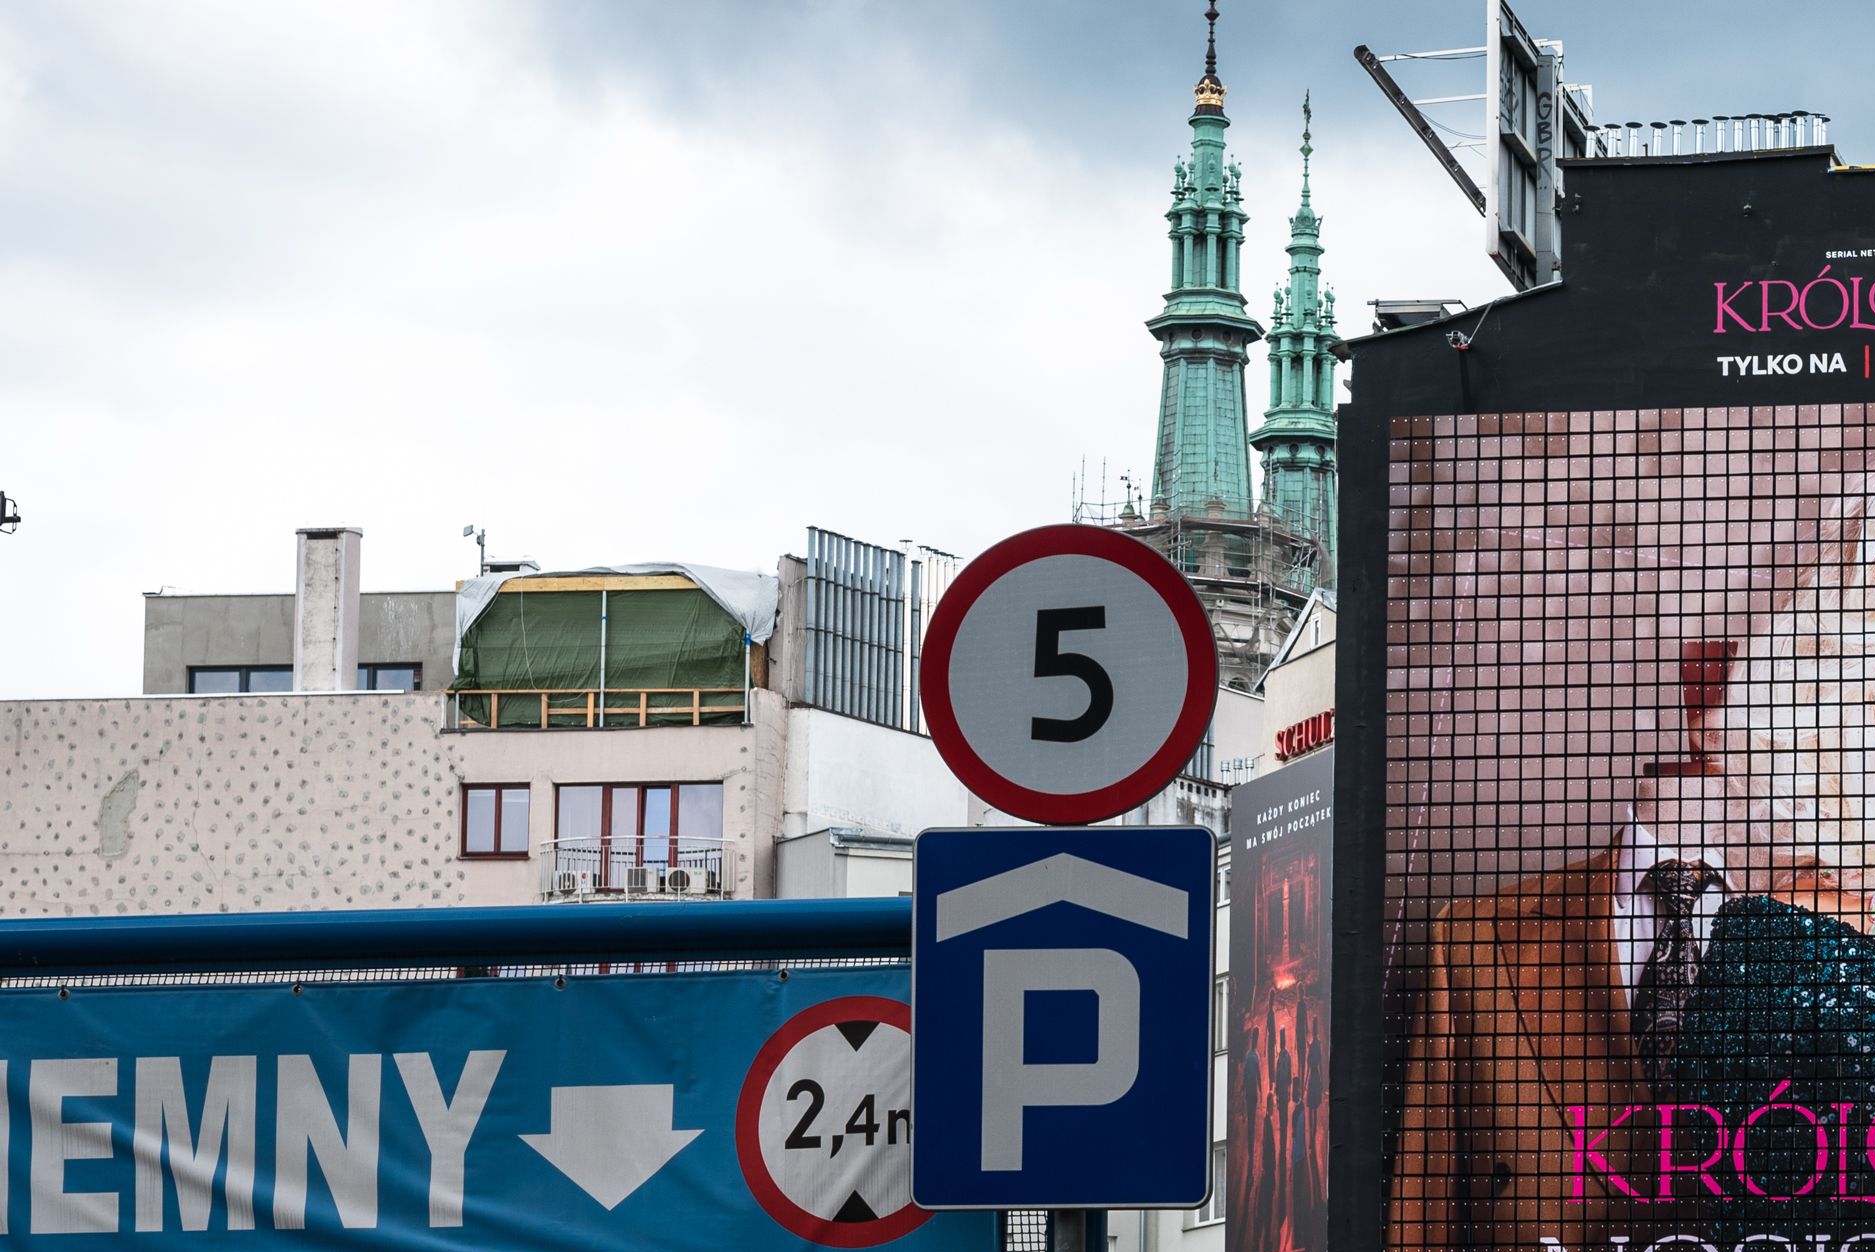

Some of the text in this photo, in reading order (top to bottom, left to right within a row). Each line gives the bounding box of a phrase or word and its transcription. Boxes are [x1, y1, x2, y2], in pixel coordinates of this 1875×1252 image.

[1825, 250, 1858, 259] SERIAL
[1716, 353, 1803, 377] TYLKO
[1809, 352, 1848, 374] NA
[1031, 605, 1114, 743] 5
[1275, 708, 1335, 761] SCHUL
[1246, 806, 1331, 850] MA SWÓJ POCZĄTEK
[1257, 789, 1320, 825] KAŻDY KONIEC
[981, 948, 1140, 1171] P
[0, 1049, 507, 1235] EMNY
